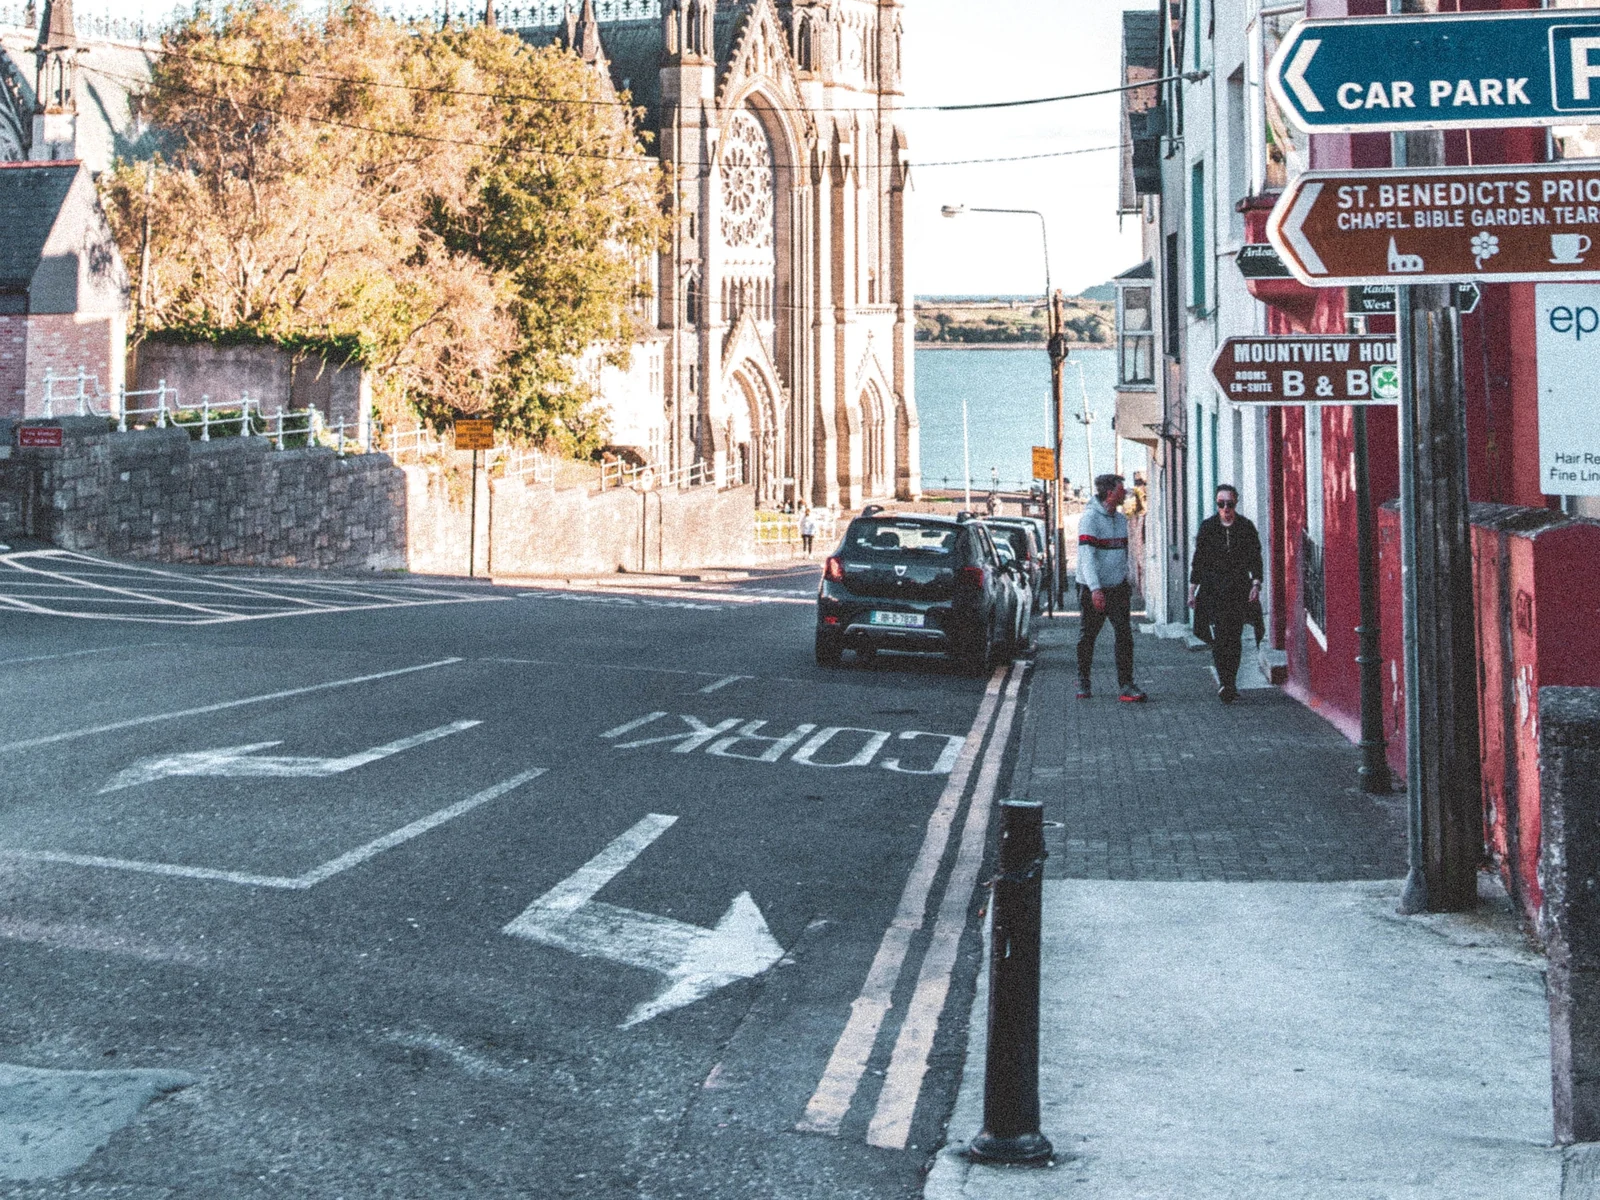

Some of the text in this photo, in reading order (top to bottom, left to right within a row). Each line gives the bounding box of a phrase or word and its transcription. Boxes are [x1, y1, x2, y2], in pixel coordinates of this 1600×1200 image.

[1336, 78, 1531, 110] CAR PARK
[1337, 179, 1600, 208] ST. BENEDICT'S PRIO
[1414, 209, 1465, 228] BIBLE
[1553, 206, 1600, 224] TEAR
[1363, 299, 1391, 309] West
[1233, 343, 1397, 363] MOUNTVIEW HOU
[1235, 371, 1267, 380] ROOMS
[1282, 369, 1369, 397] B & B
[1230, 383, 1273, 392] EN-SUITE
[1555, 452, 1600, 465] Hair Re
[1550, 468, 1600, 481] Fine Lin
[614, 714, 967, 775] CORK
